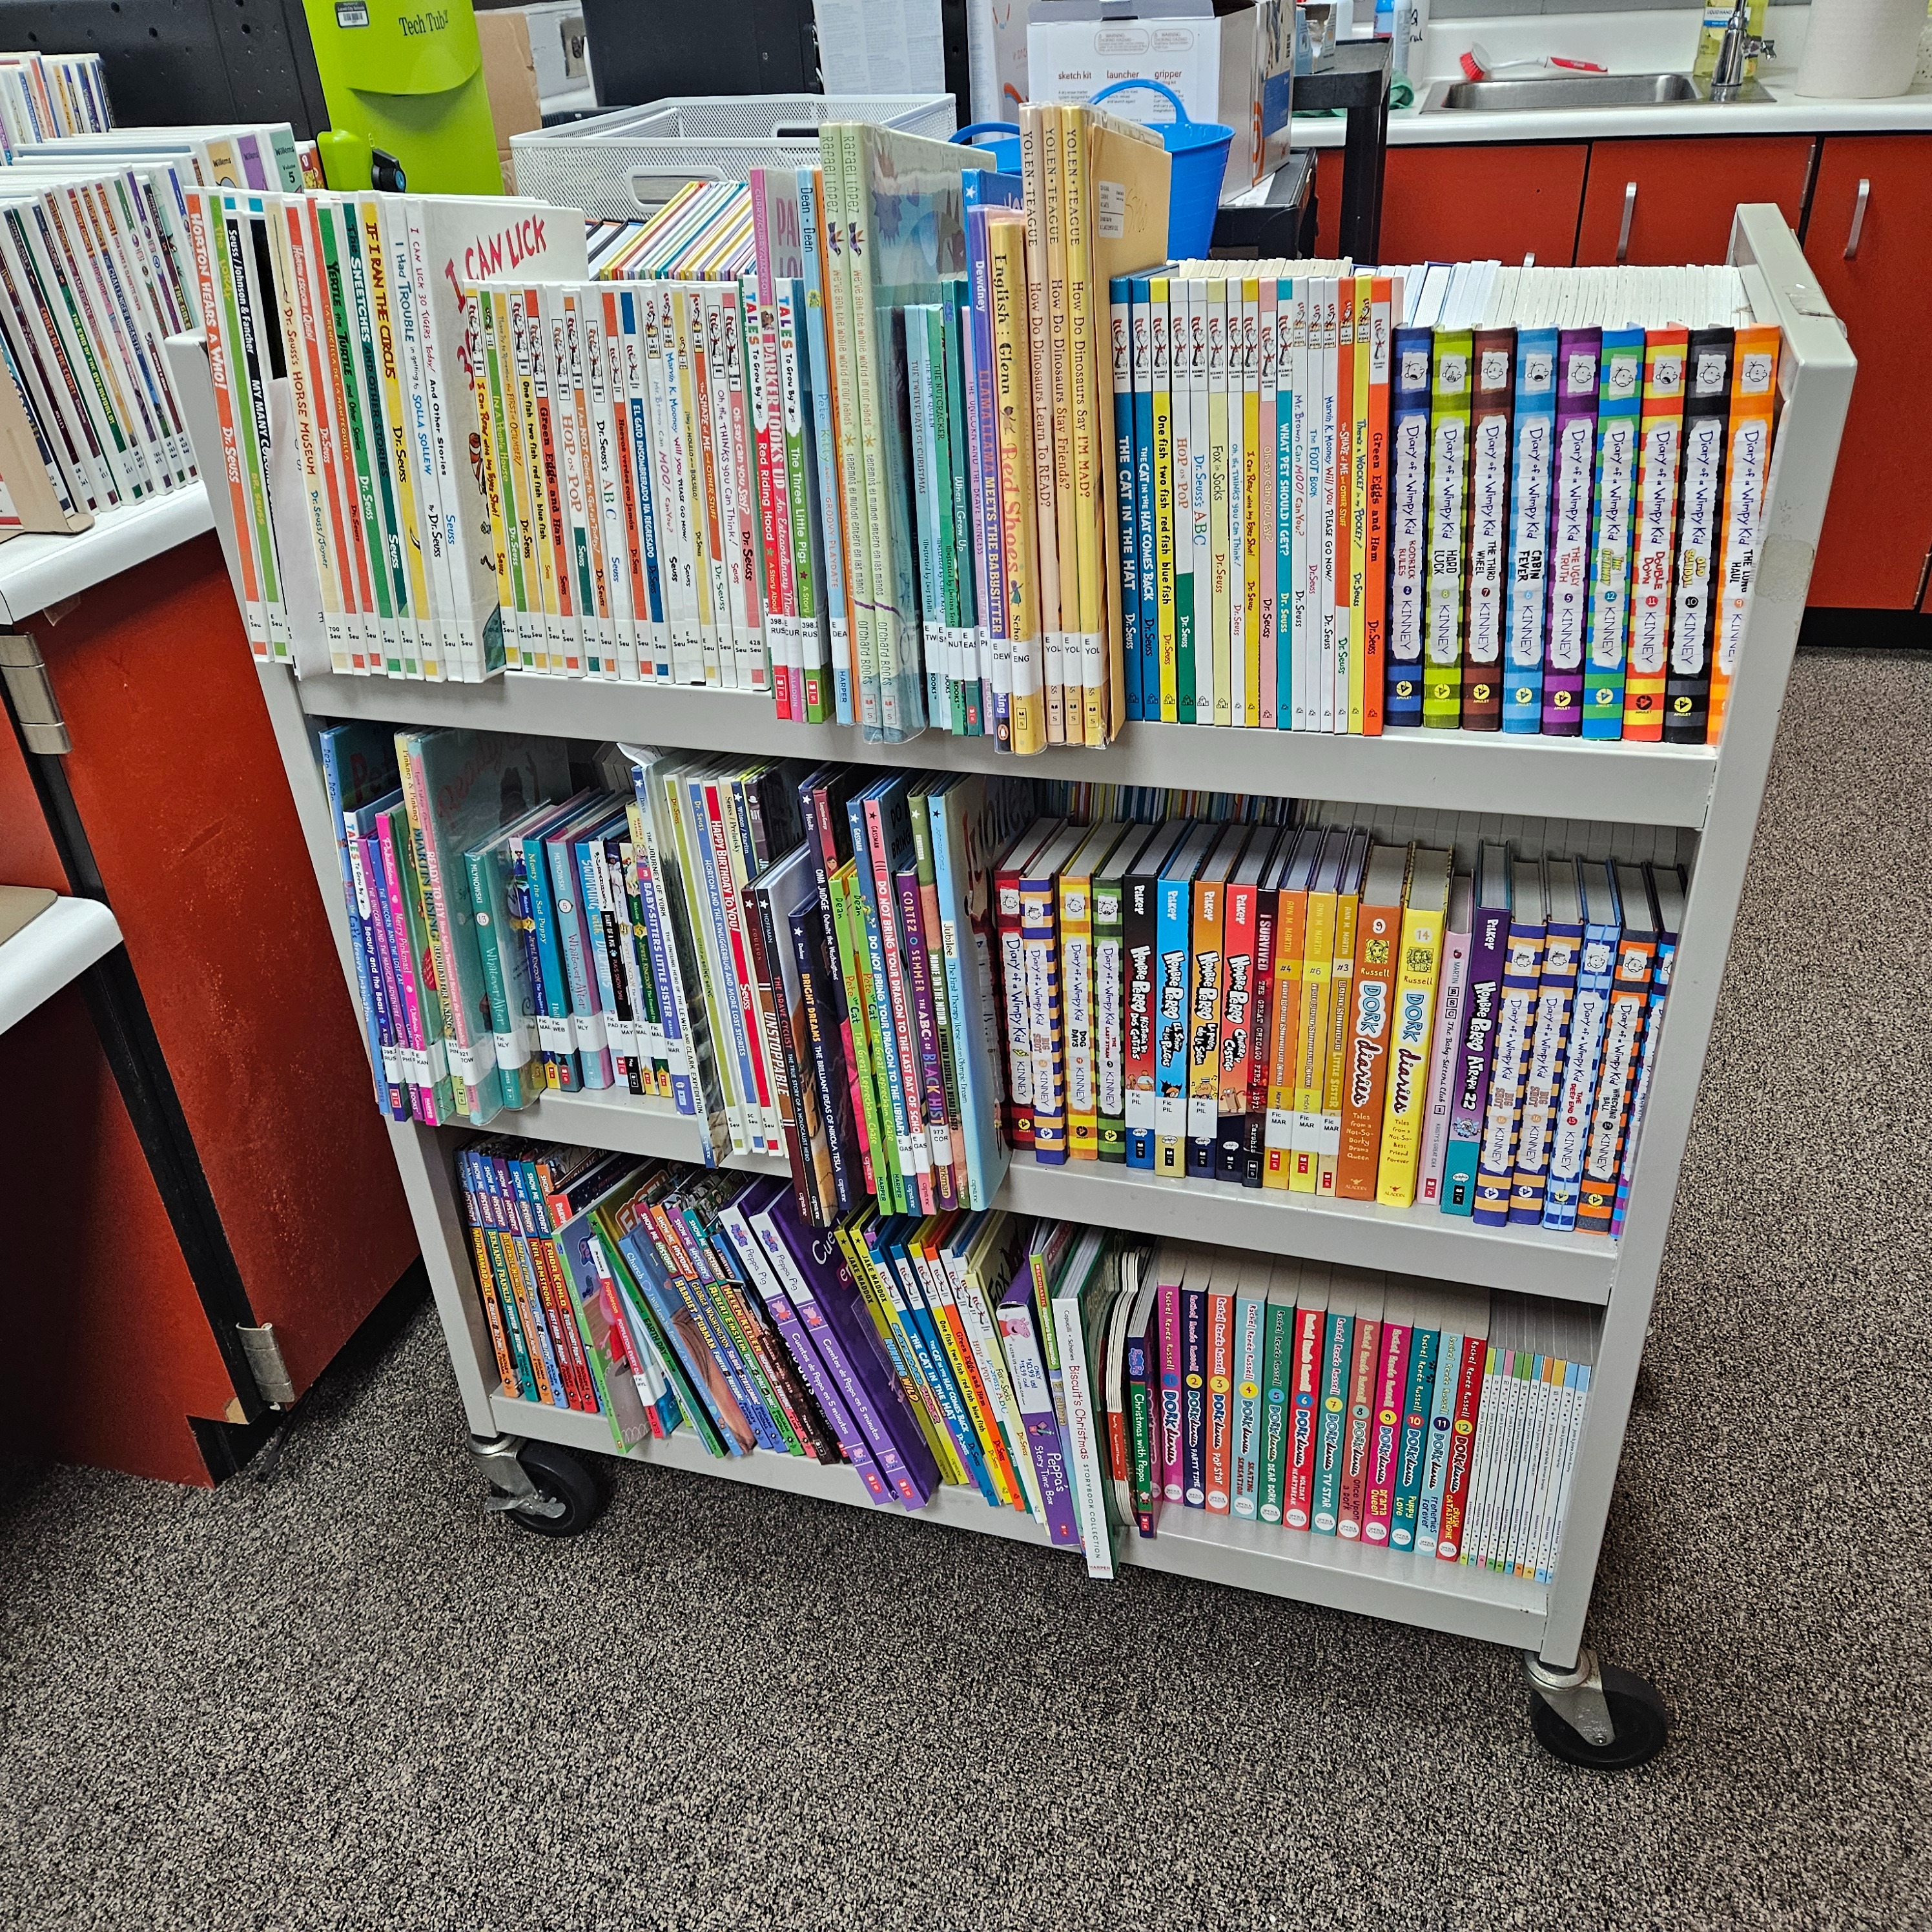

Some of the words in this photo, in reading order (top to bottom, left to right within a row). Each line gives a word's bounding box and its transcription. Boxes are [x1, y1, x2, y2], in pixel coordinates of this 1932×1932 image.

[398, 14, 426, 36] Tech
[1058, 70, 1081, 81] sketch
[1083, 70, 1092, 81] kit
[1107, 70, 1140, 80] launcher
[1155, 70, 1182, 81] gripper
[212, 158, 232, 167] Willems
[274, 146, 294, 156] Willems
[1067, 129, 1078, 176] YOLEN
[288, 171, 295, 183] 5
[1069, 187, 1080, 246] TEAGUE
[189, 213, 209, 276] HORTON
[365, 222, 378, 242] IF
[465, 235, 502, 280] CAN
[506, 214, 546, 269] LICK
[368, 245, 380, 255] I
[370, 258, 385, 287] RAN
[975, 260, 985, 313] Dewdney
[201, 282, 217, 327] HEARS
[994, 254, 1008, 325] English
[1072, 282, 1084, 311] How
[107, 265, 129, 317] CHALLENGER
[126, 318, 142, 356] DISASTER
[375, 289, 389, 322] THE
[779, 294, 794, 349] TALES
[1073, 314, 1082, 335] Do
[208, 333, 216, 342] A
[380, 326, 396, 379] CIRCUS
[207, 344, 227, 390] WHO!
[785, 353, 792, 364] To
[999, 342, 1011, 395] Glenn
[1074, 340, 1086, 404] Dinosaurs
[786, 365, 794, 384] Grow
[1076, 408, 1087, 431] Say
[1078, 435, 1089, 458] I'M
[1118, 435, 1130, 464] THE
[1280, 423, 1289, 453] WHAT
[1372, 432, 1382, 468] Green
[1444, 429, 1457, 461] Diary
[791, 447, 799, 469] The
[1002, 443, 1018, 496] Red
[1280, 456, 1289, 476] PET
[1446, 465, 1455, 475] of
[793, 471, 802, 503] Three
[1079, 462, 1090, 498] MAD?
[1119, 471, 1131, 502] CAT
[1370, 471, 1382, 505] Eggs
[1122, 506, 1131, 520] IN
[1280, 480, 1289, 520] SHOULD
[1441, 485, 1457, 524] Wimpy
[1005, 498, 1020, 573] Shoes
[1372, 509, 1380, 533] and
[1441, 524, 1454, 540] Kid
[798, 536, 807, 564] Pigs
[1122, 525, 1133, 554] THE
[1280, 530, 1290, 555] GET?
[1370, 537, 1379, 562] Ham
[1123, 560, 1136, 590] HAT
[1435, 550, 1444, 574] LUCK
[1446, 550, 1457, 574] HARD
[1518, 551, 1528, 582] FEVER
[1530, 550, 1543, 580] CABIN
[1647, 596, 1657, 607] 11
[1438, 604, 1450, 655] KINNEY
[711, 820, 724, 849] HAPPY
[470, 863, 482, 904] MLYNOWSKI
[716, 850, 733, 897] BIRTHDAY
[878, 881, 886, 894] DO
[724, 897, 734, 908] TO
[879, 895, 889, 917] NOT
[477, 915, 487, 923] 13
[582, 859, 595, 910] SWIMMING
[596, 939, 611, 988] DOLPHINS
[727, 907, 740, 932] YOU!
[1375, 920, 1384, 932] 9
[644, 882, 662, 951] BABY-SITTERS
[654, 952, 667, 983] LITTLE
[661, 985, 673, 1018] SISTER
[882, 920, 894, 952] BRING
[1258, 921, 1271, 971] SURVIVED
[887, 954, 899, 981] YOUR
[1361, 967, 1390, 978] Russell
[740, 983, 751, 1010] Seuss
[802, 974, 815, 1007] BRIGHT
[891, 983, 905, 1019] DRAGON
[1361, 984, 1381, 1033] DORK
[807, 1007, 821, 1042] DREAMS
[897, 1022, 906, 1034] TO
[764, 1011, 788, 1096] UNSTOPPABLE
[898, 1035, 908, 1052] THE
[901, 1052, 911, 1073] LAST
[1353, 1040, 1382, 1105] diaries
[903, 1075, 913, 1094] DAY
[908, 1096, 917, 1108] OF
[1610, 1088, 1620, 1119] WRECKING
[910, 1109, 920, 1134] SCHO
[1349, 1137, 1369, 1146] Dorky
[1560, 1131, 1574, 1171] KINNEY
[471, 1228, 489, 1284] MUHAMMAD
[484, 1284, 492, 1298] ALI
[776, 1254, 791, 1277] Peppa
[788, 1277, 797, 1291] Pig
[604, 1282, 618, 1313] Poppleton
[1217, 1297, 1227, 1322] Rachel
[675, 1279, 697, 1312] HARRIET
[693, 1313, 715, 1349] TUBMAN
[644, 1318, 661, 1344] EARTH
[656, 1342, 668, 1356] DAY
[1216, 1350, 1225, 1375] Russell
[823, 1339, 840, 1369] Cuentos
[838, 1369, 846, 1379] de
[843, 1378, 858, 1398] Peppa
[854, 1396, 863, 1406] en
[859, 1406, 866, 1415] 5
[863, 1415, 881, 1441] minutos
[1069, 1364, 1083, 1406] Biscuit's
[1134, 1393, 1144, 1440] Christmas
[1409, 1416, 1419, 1425] 10
[1074, 1410, 1089, 1460] Christmas
[1034, 1445, 1043, 1468] Story
[1040, 1470, 1050, 1488] Time
[1045, 1490, 1053, 1505] Box
[1046, 1452, 1064, 1492] Peppa's
[1083, 1464, 1094, 1508] STORYBOOK
[1138, 1461, 1146, 1483] Peppa
[1324, 1474, 1331, 1483] TV
[1088, 1510, 1101, 1559] COLLECTION
